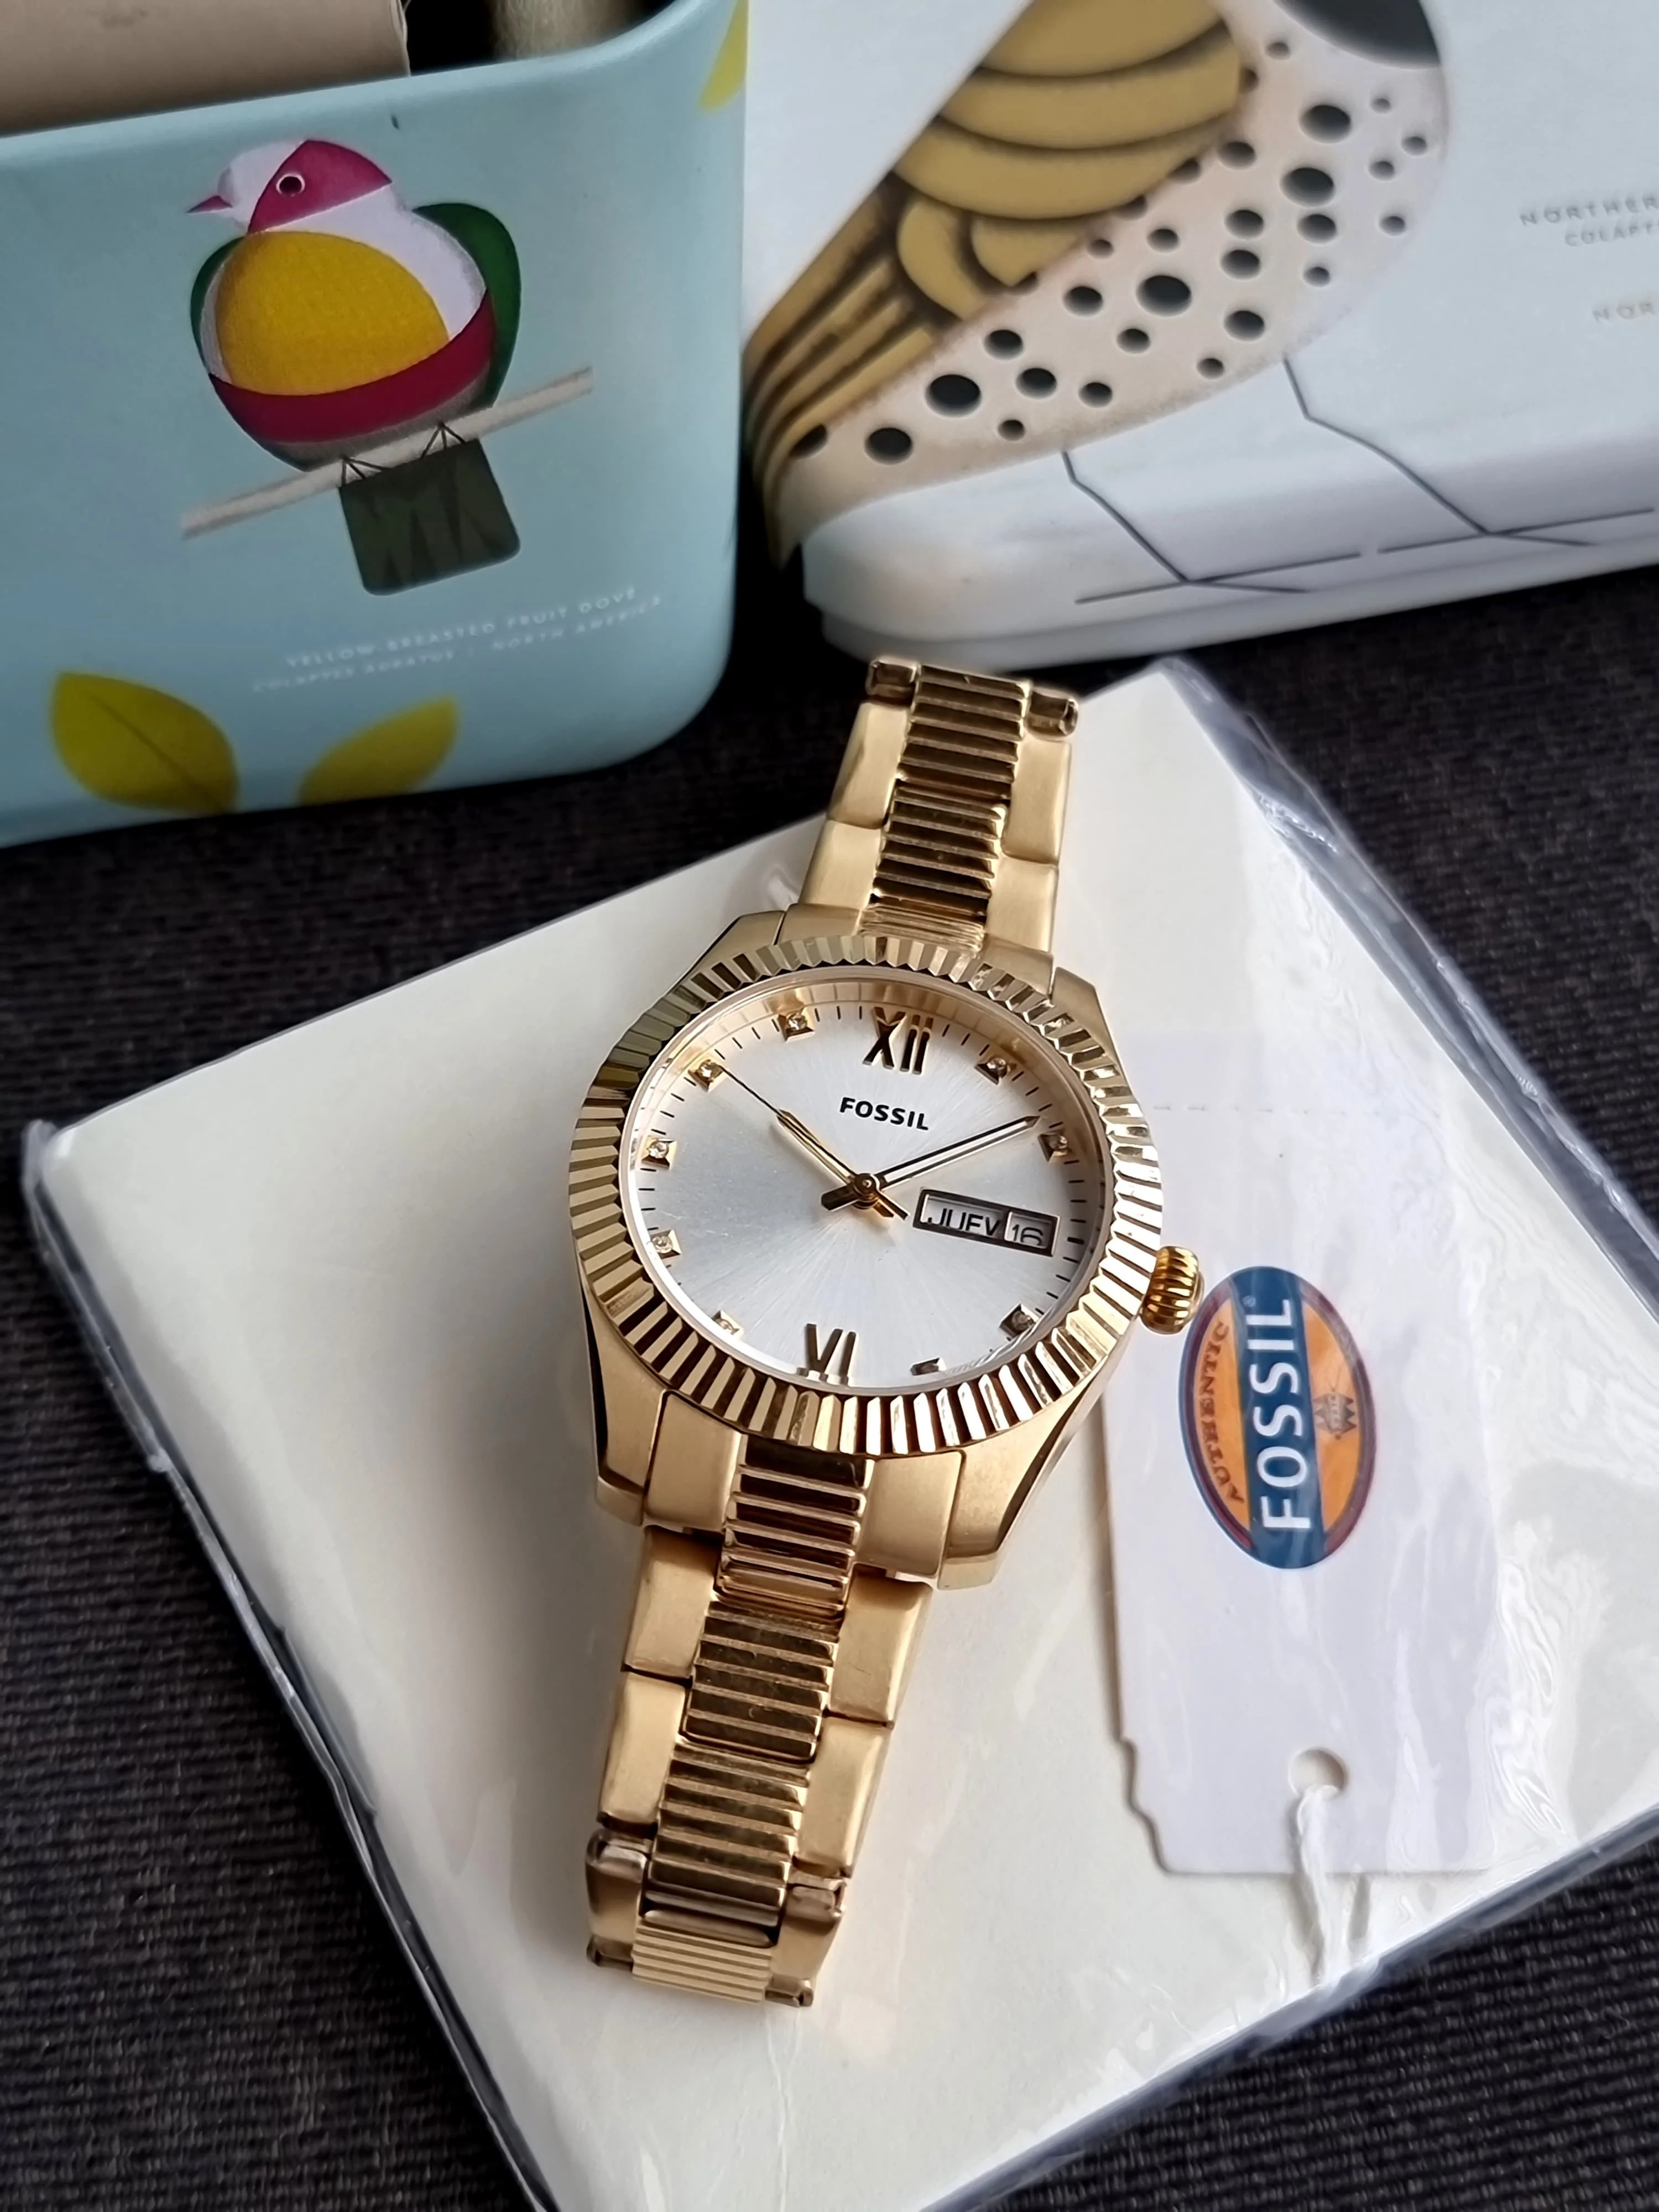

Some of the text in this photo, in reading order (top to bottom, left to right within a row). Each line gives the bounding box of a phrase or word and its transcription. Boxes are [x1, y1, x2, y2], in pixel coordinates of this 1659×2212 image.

[862, 1008, 935, 1074] XII
[839, 1097, 929, 1131] FOSSIL
[1011, 1223, 1044, 1246] 16
[1199, 1322, 1245, 1504] AUTHENTIC
[1245, 1298, 1311, 1529] FOSSIL
